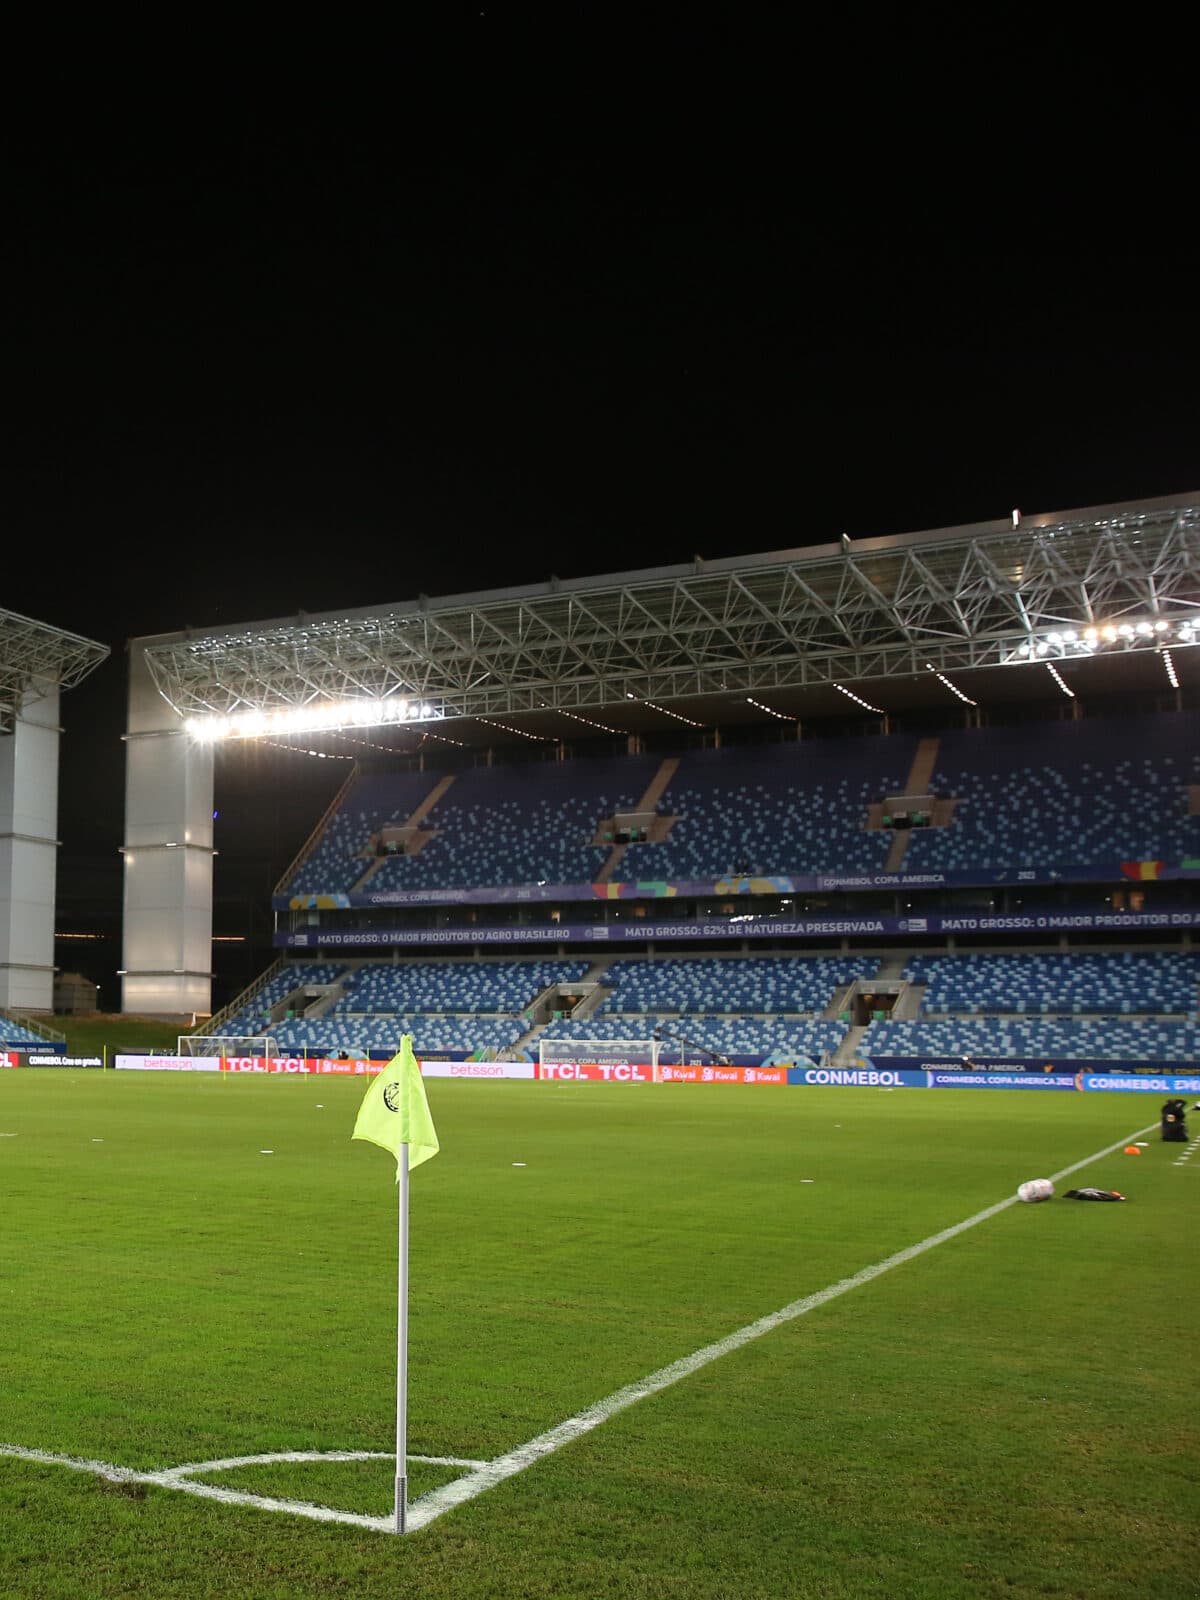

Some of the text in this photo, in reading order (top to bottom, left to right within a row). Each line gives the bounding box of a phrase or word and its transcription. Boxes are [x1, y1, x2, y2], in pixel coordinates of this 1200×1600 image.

[874, 876, 899, 885] COPA
[901, 874, 945, 883] AMERICA
[625, 920, 884, 937] MATO GROSSO: 62% DE NATUREZA PRESERVADA
[941, 918, 975, 930] MATO
[979, 916, 1035, 929] GROSSO:
[1037, 917, 1047, 928] O
[1050, 915, 1092, 927] MAIOR
[1095, 914, 1169, 926] PRODUTOR
[1171, 913, 1192, 924] DO
[317, 935, 343, 944] MATO
[343, 934, 381, 945] GROSSO:
[390, 932, 420, 943] MAIOR
[420, 931, 470, 943] PRODUTOR
[471, 930, 485, 941] DO
[486, 930, 512, 941] AGRO
[513, 928, 570, 940] BRASILEIRO
[144, 1057, 193, 1069] betsson
[227, 1057, 310, 1073] TCL TCL
[544, 1057, 577, 1065] CONMEBOL
[578, 1057, 597, 1065] COPA
[451, 1063, 504, 1076] betsson
[544, 1064, 645, 1081] TCL TCL
[673, 1068, 781, 1082] Kwai Kwai Kwai
[805, 1070, 905, 1086] CONMEBOL
[936, 1075, 987, 1085] CONMEBOL
[988, 1075, 1013, 1085] COPA
[1013, 1075, 1054, 1086] AMERICA
[1088, 1078, 1170, 1091] CONMEBOL
